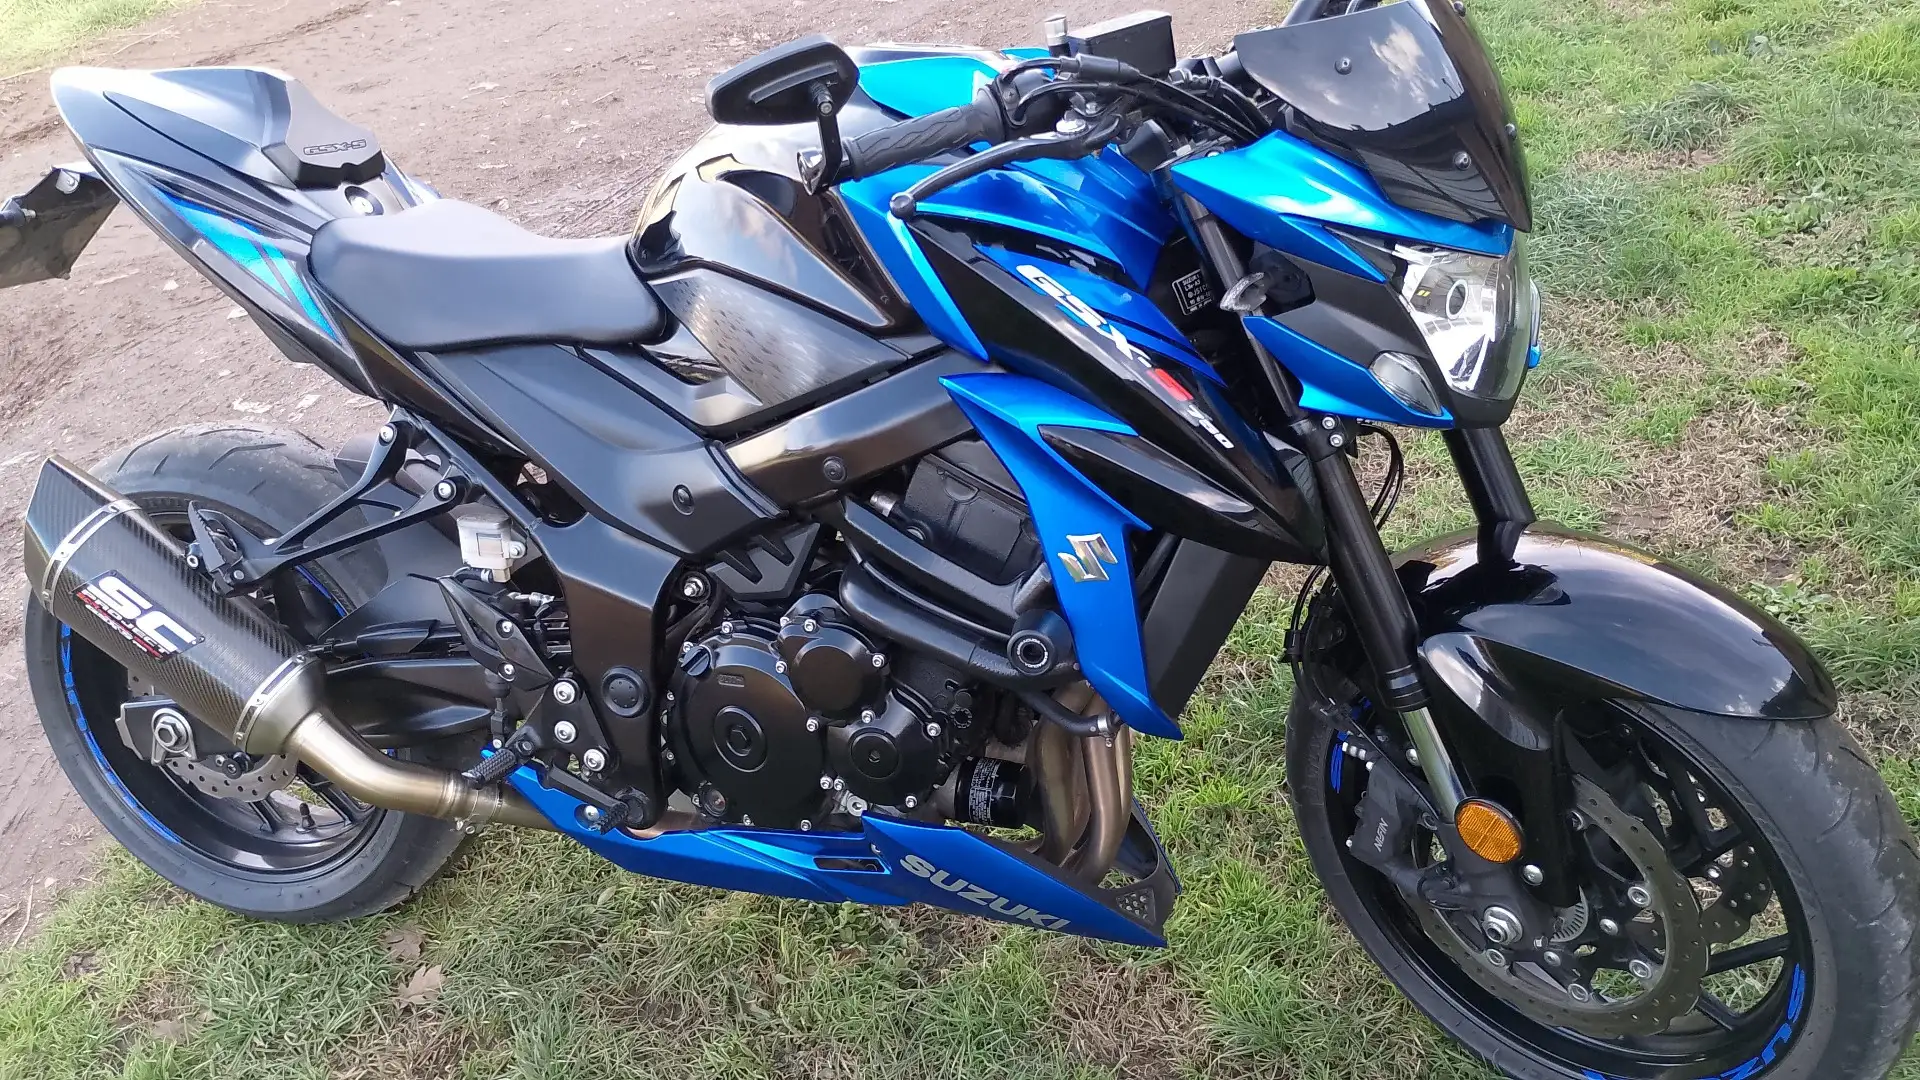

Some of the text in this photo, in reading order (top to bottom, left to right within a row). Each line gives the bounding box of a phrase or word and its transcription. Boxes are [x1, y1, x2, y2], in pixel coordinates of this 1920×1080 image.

[302, 139, 367, 155] GSX-S
[1016, 264, 1235, 449] GSX-S 750
[81, 588, 171, 656] PROJECT
[900, 854, 1071, 930] SUZUKI
